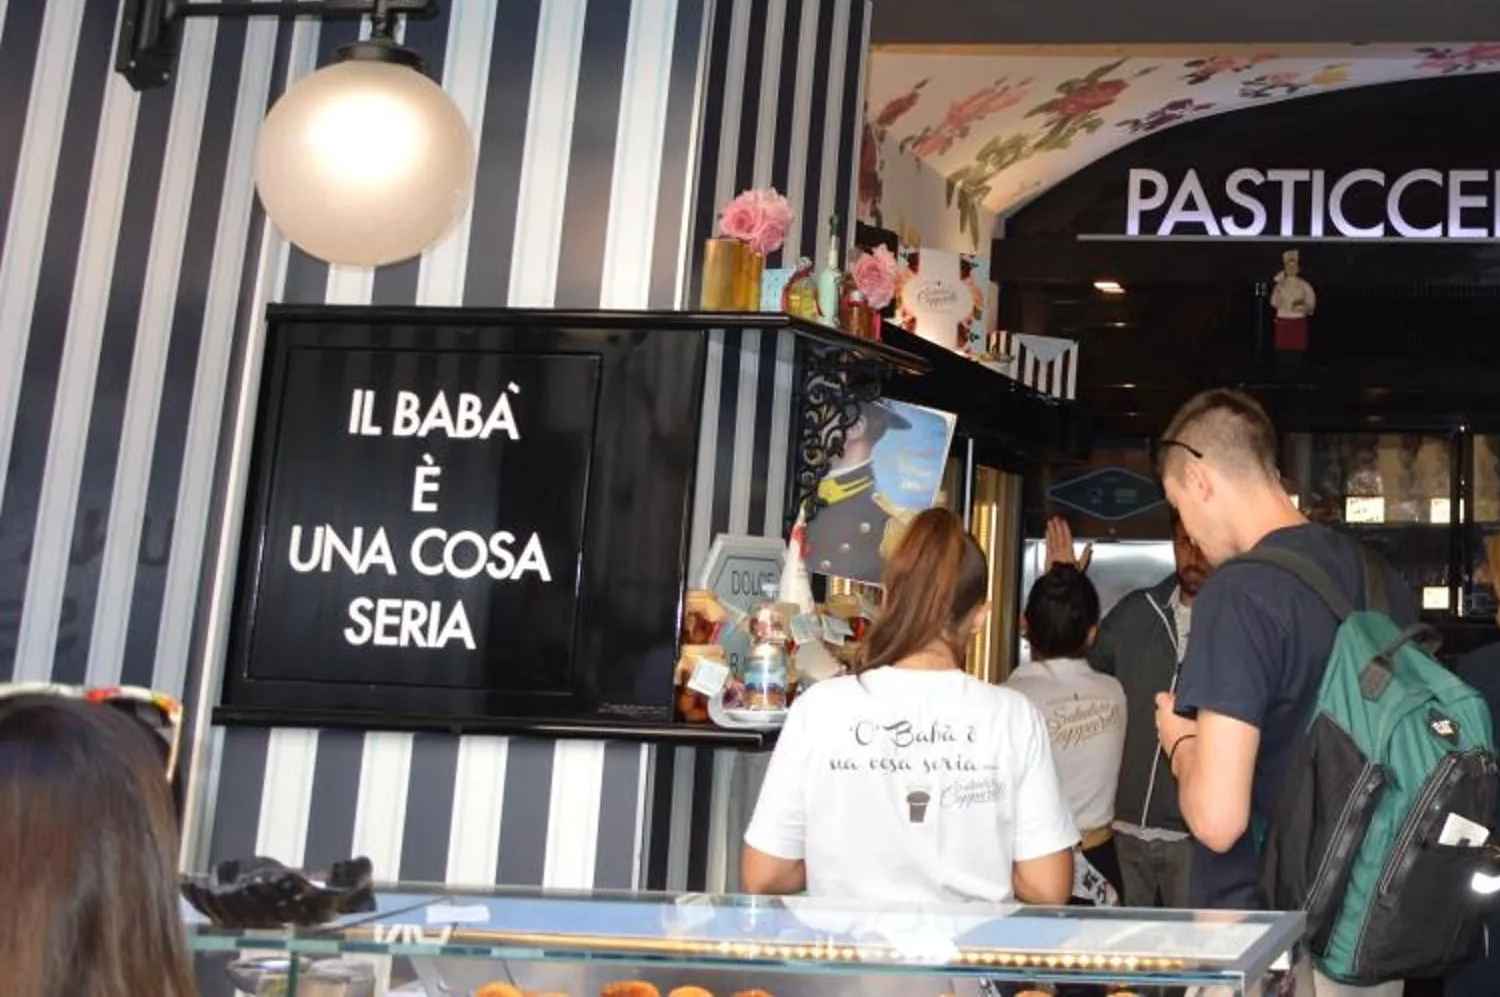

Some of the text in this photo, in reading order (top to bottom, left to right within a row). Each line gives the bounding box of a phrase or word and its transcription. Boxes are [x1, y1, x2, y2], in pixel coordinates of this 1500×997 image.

[349, 381, 521, 440] IL BABÀ
[411, 453, 441, 512] È
[288, 524, 552, 582] UNA COSA
[343, 597, 477, 650] SERIA
